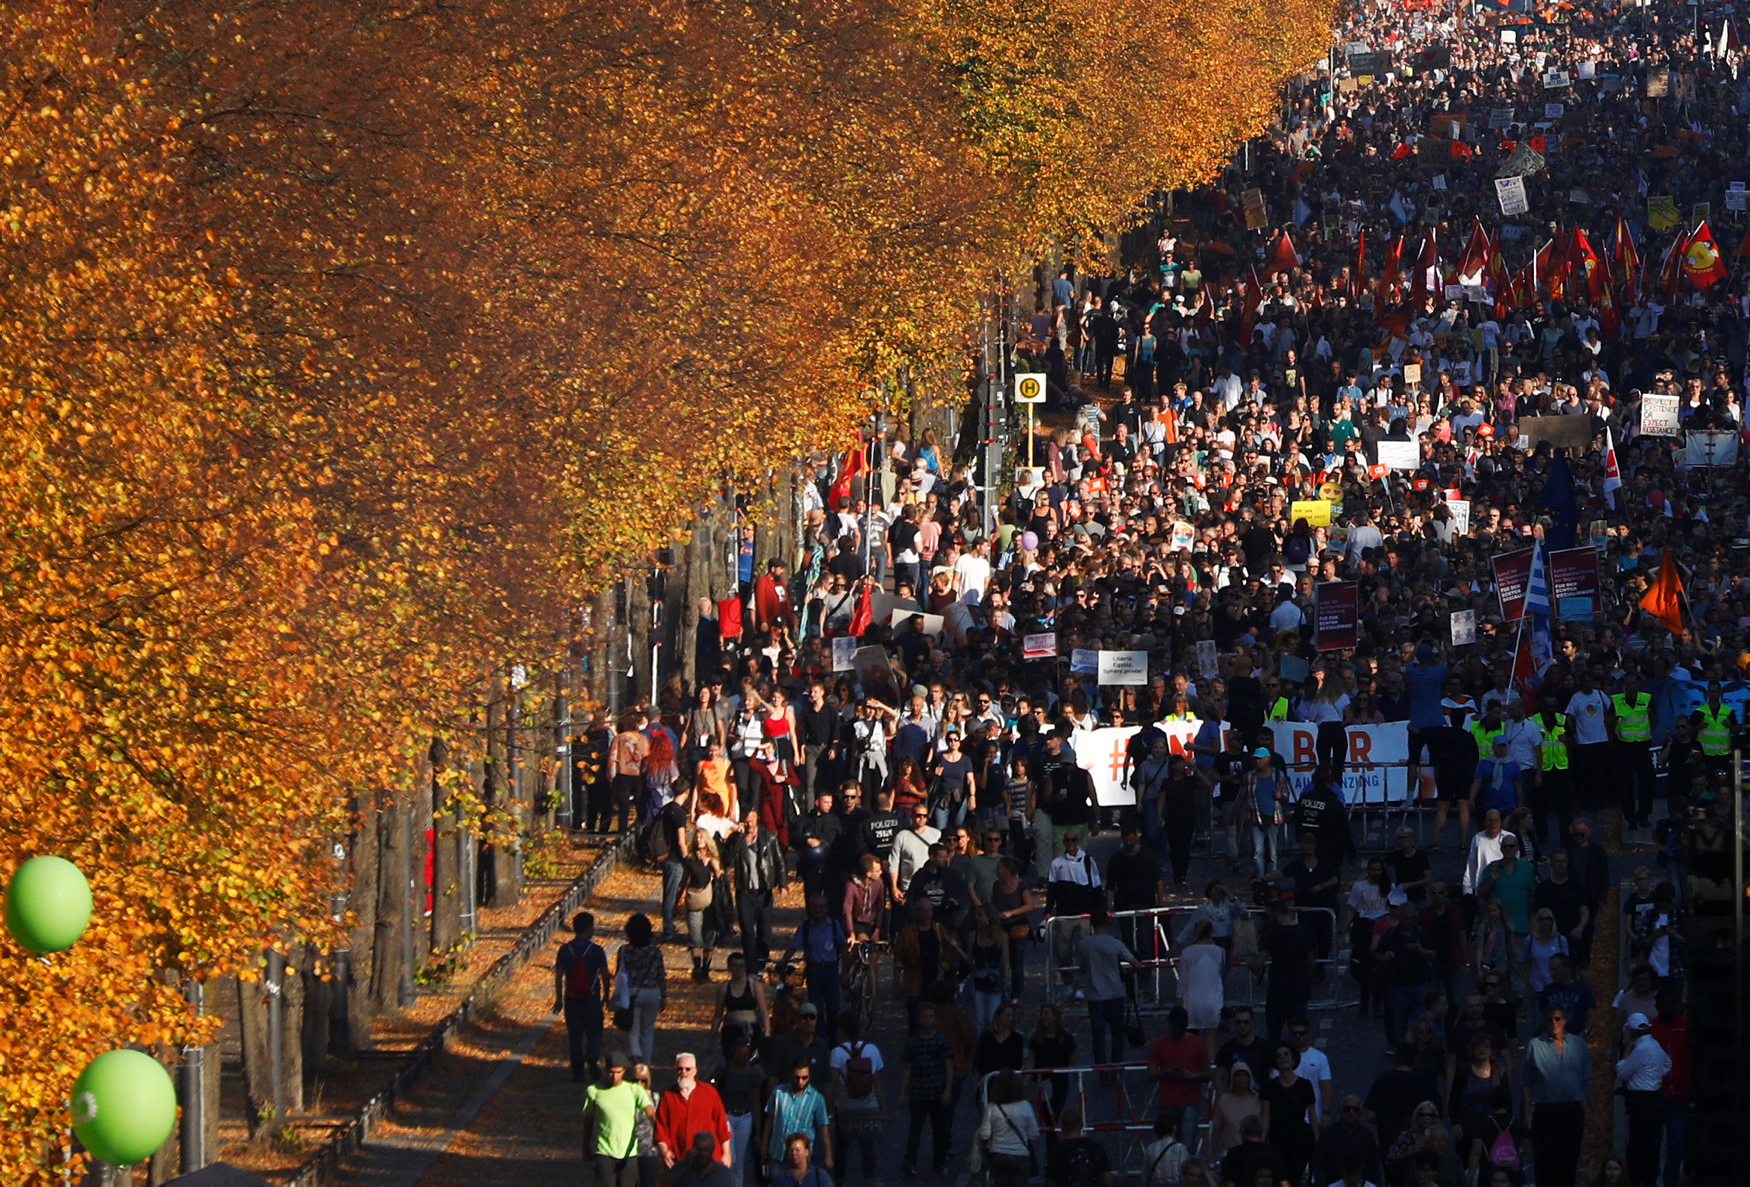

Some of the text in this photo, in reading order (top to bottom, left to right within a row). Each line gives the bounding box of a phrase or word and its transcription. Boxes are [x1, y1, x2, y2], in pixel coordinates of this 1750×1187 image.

[1644, 397, 1673, 406] RESPECT
[1644, 411, 1653, 419] OR
[1643, 419, 1669, 427] EXPECT
[870, 819, 899, 831] POLIZEI
